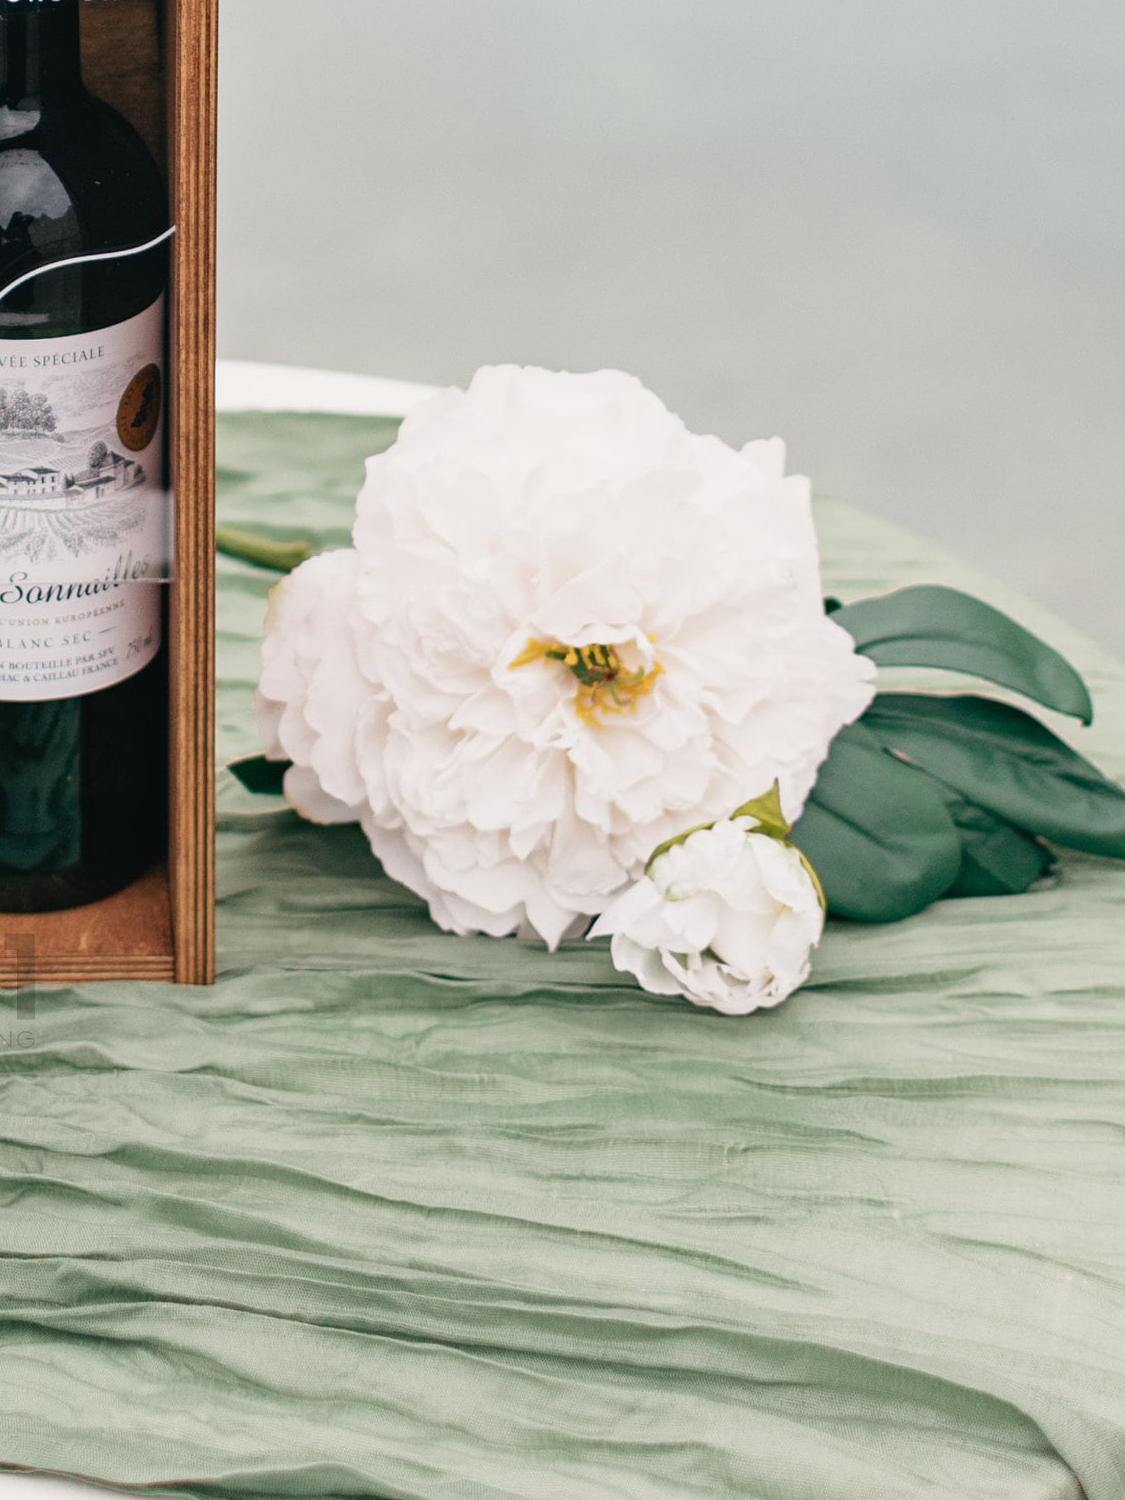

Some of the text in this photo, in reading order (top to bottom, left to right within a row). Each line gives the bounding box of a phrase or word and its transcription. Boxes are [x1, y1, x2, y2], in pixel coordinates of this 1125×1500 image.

[33, 345, 106, 368] SPÉCIALE
[60, 630, 92, 646] SEC
[8, 658, 73, 670] BOUTEILLE
[76, 653, 95, 665] PAR
[82, 657, 118, 675] FRANCE
